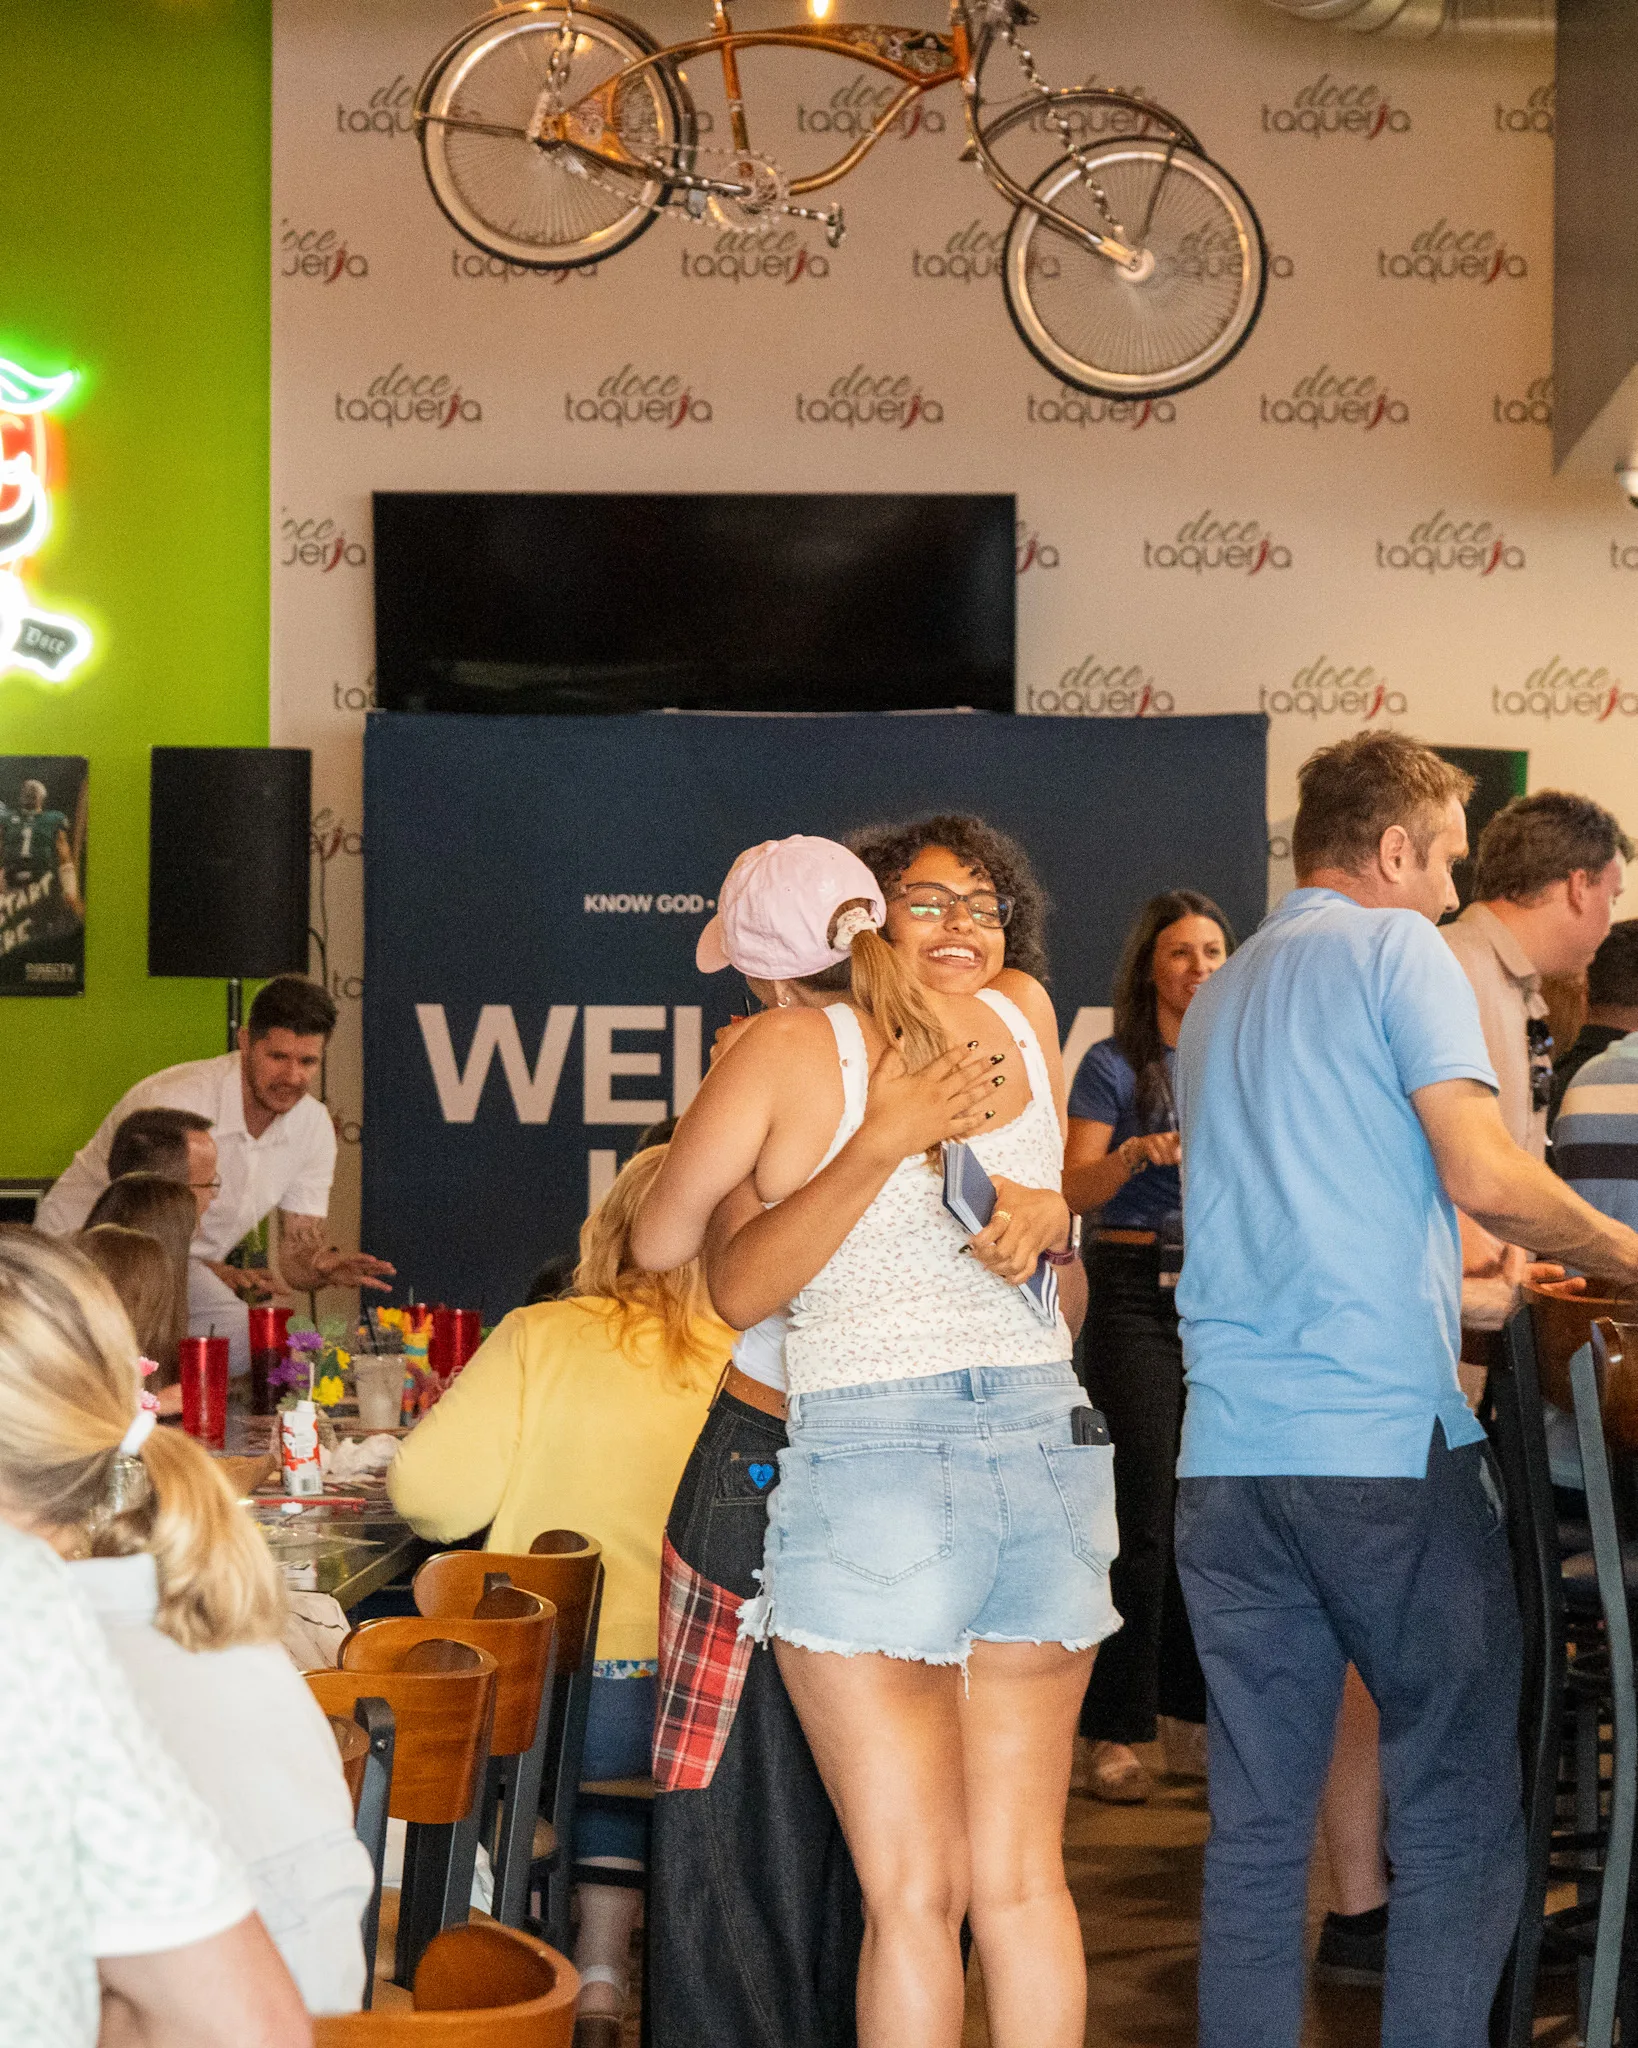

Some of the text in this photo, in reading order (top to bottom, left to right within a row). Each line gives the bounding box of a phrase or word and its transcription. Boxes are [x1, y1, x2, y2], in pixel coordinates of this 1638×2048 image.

[1294, 73, 1379, 109] doce
[1410, 218, 1496, 254] doce
[367, 363, 451, 399] doce
[596, 363, 680, 399] doce
[827, 363, 912, 399] doce
[1292, 364, 1378, 400] doce
[1176, 509, 1260, 544] doce
[1408, 508, 1494, 545] doce
[1058, 653, 1143, 689] doce
[1291, 654, 1375, 690] doce
[1524, 654, 1609, 690] doce
[583, 893, 705, 914] KNOW GOD
